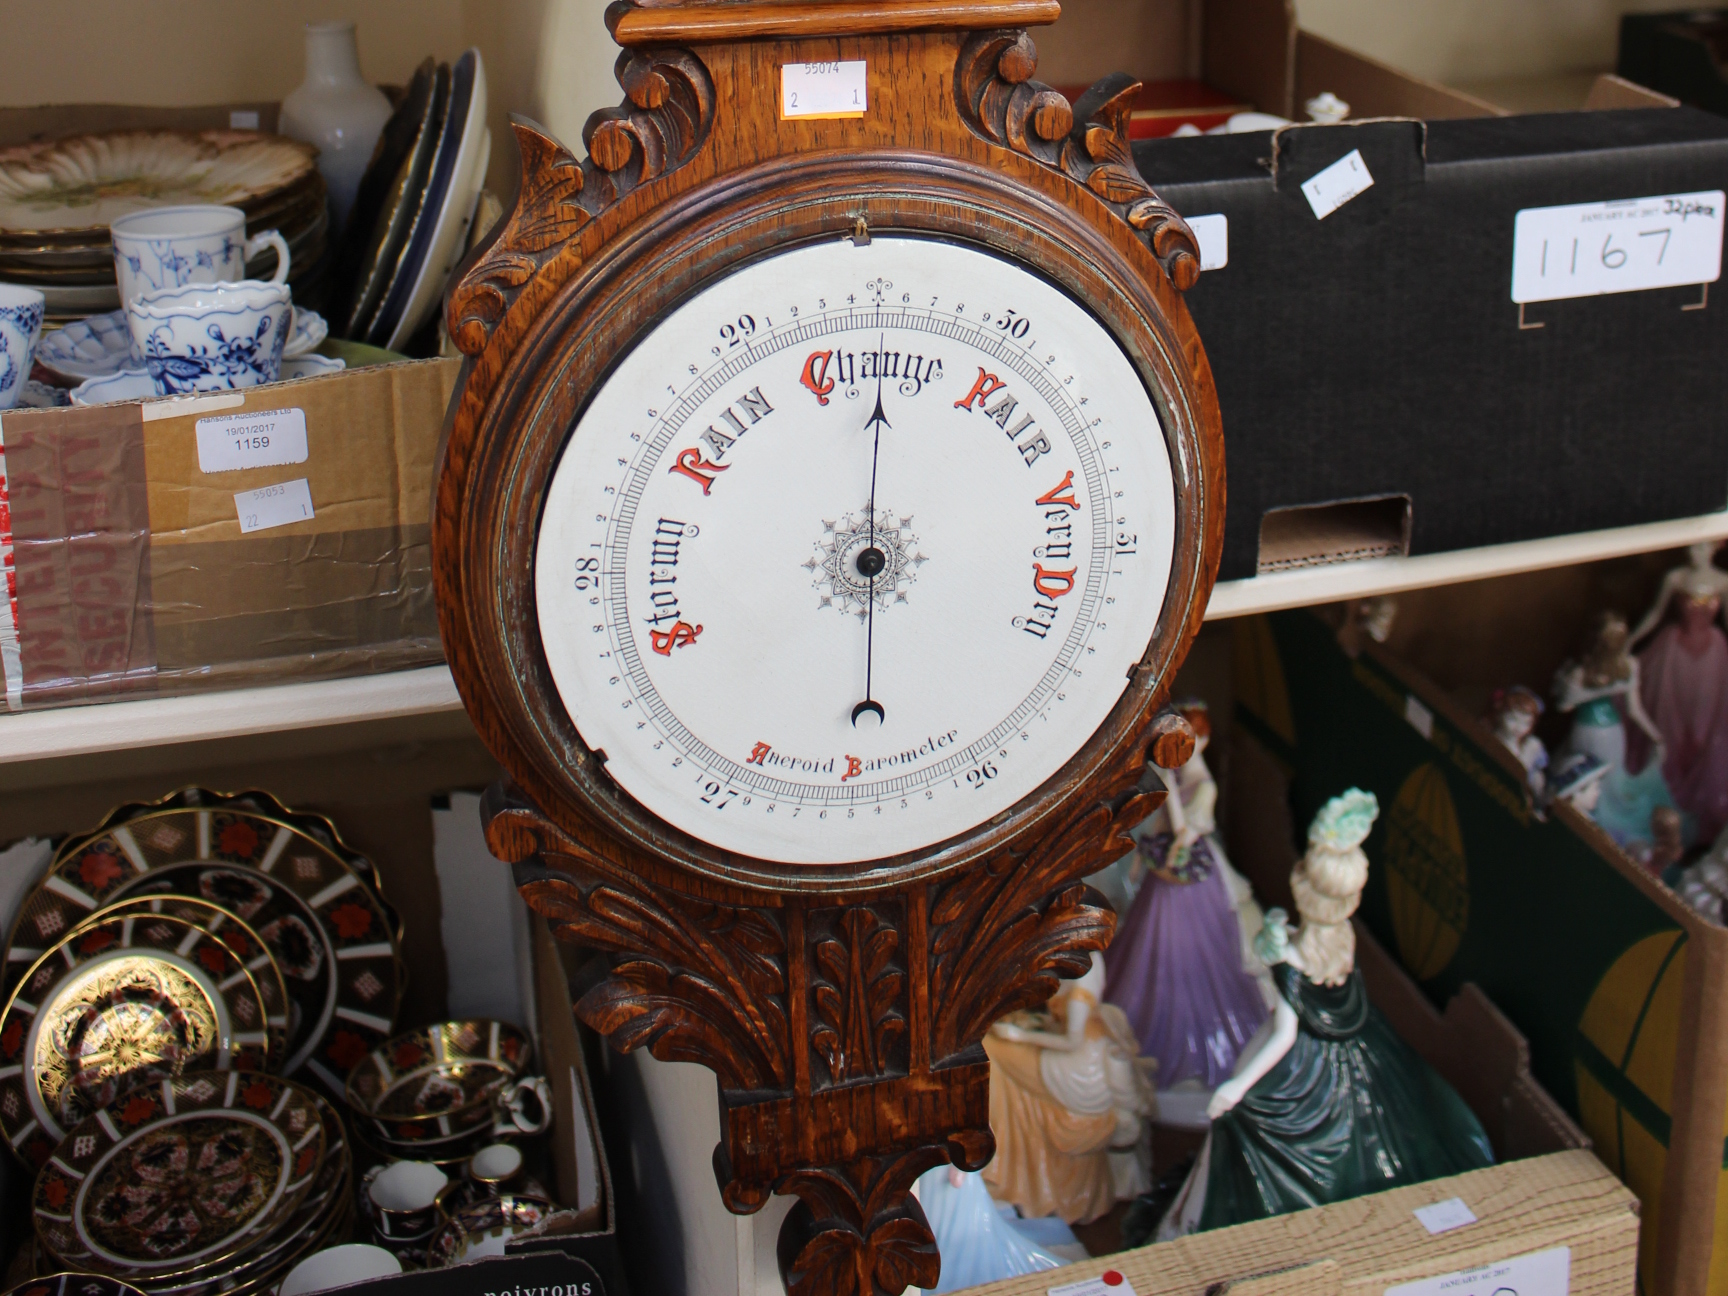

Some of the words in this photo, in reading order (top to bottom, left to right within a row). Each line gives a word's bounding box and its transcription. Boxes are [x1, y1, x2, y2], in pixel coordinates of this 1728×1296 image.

[805, 62, 839, 75] 55074
[791, 92, 798, 108] 2
[853, 89, 861, 105] 1
[1540, 228, 1673, 278] 1167
[847, 293, 856, 304] 4
[902, 293, 910, 303] 6
[931, 296, 938, 306] 7
[819, 298, 827, 309] 3
[956, 303, 965, 313] 8
[790, 306, 799, 317] 2
[765, 316, 773, 327] 1
[983, 312, 991, 322] 9
[995, 309, 1030, 339] 30
[719, 314, 756, 347] 29
[1028, 340, 1037, 350] 1
[711, 346, 721, 357] 9
[1045, 355, 1055, 365] 2
[688, 364, 698, 375] 8
[799, 345, 943, 406] Change
[1064, 375, 1074, 385] 3
[667, 385, 677, 395] 7
[1079, 396, 1089, 406] 4
[647, 408, 657, 418] 6
[953, 366, 1052, 468] FAIR
[1092, 417, 1102, 427] 5
[226, 423, 276, 436] 19/01/2017
[630, 432, 641, 442] 5
[668, 386, 775, 496] RAIN
[234, 436, 270, 451] 1159
[1102, 441, 1111, 450] 6
[617, 456, 628, 467] 4
[253, 485, 285, 502] 55053
[604, 486, 615, 495] 3
[1114, 490, 1124, 498] 8
[246, 513, 260, 528] 22
[301, 503, 308, 516] 1
[596, 514, 607, 522] 2
[1033, 470, 1081, 559] Very
[1116, 516, 1126, 525] 9
[1115, 533, 1137, 555] 31
[574, 557, 600, 591] 28
[642, 518, 703, 657] Stormy
[1011, 562, 1078, 639] Dry
[1106, 597, 1116, 605] 2
[593, 624, 604, 633] 8
[1097, 622, 1107, 630] 3
[1087, 646, 1096, 654] 4
[1073, 669, 1083, 678] 5
[622, 700, 632, 709] 5
[1040, 713, 1048, 722] 7
[636, 720, 646, 730] 4
[1021, 732, 1029, 741] 8
[653, 740, 664, 750] 3
[746, 740, 834, 773] Aneroid
[841, 729, 958, 782] Barometer
[672, 757, 683, 768] 2
[695, 774, 704, 783] 1
[966, 760, 998, 789] 26
[953, 779, 959, 788] 1
[700, 782, 739, 810] 27
[925, 791, 933, 800] 2
[743, 796, 751, 806] 9
[900, 800, 908, 809] 3
[767, 803, 775, 814] 8
[792, 807, 801, 818] 7
[847, 808, 854, 819] 5
[874, 806, 882, 815] 4
[819, 809, 827, 819] 6
